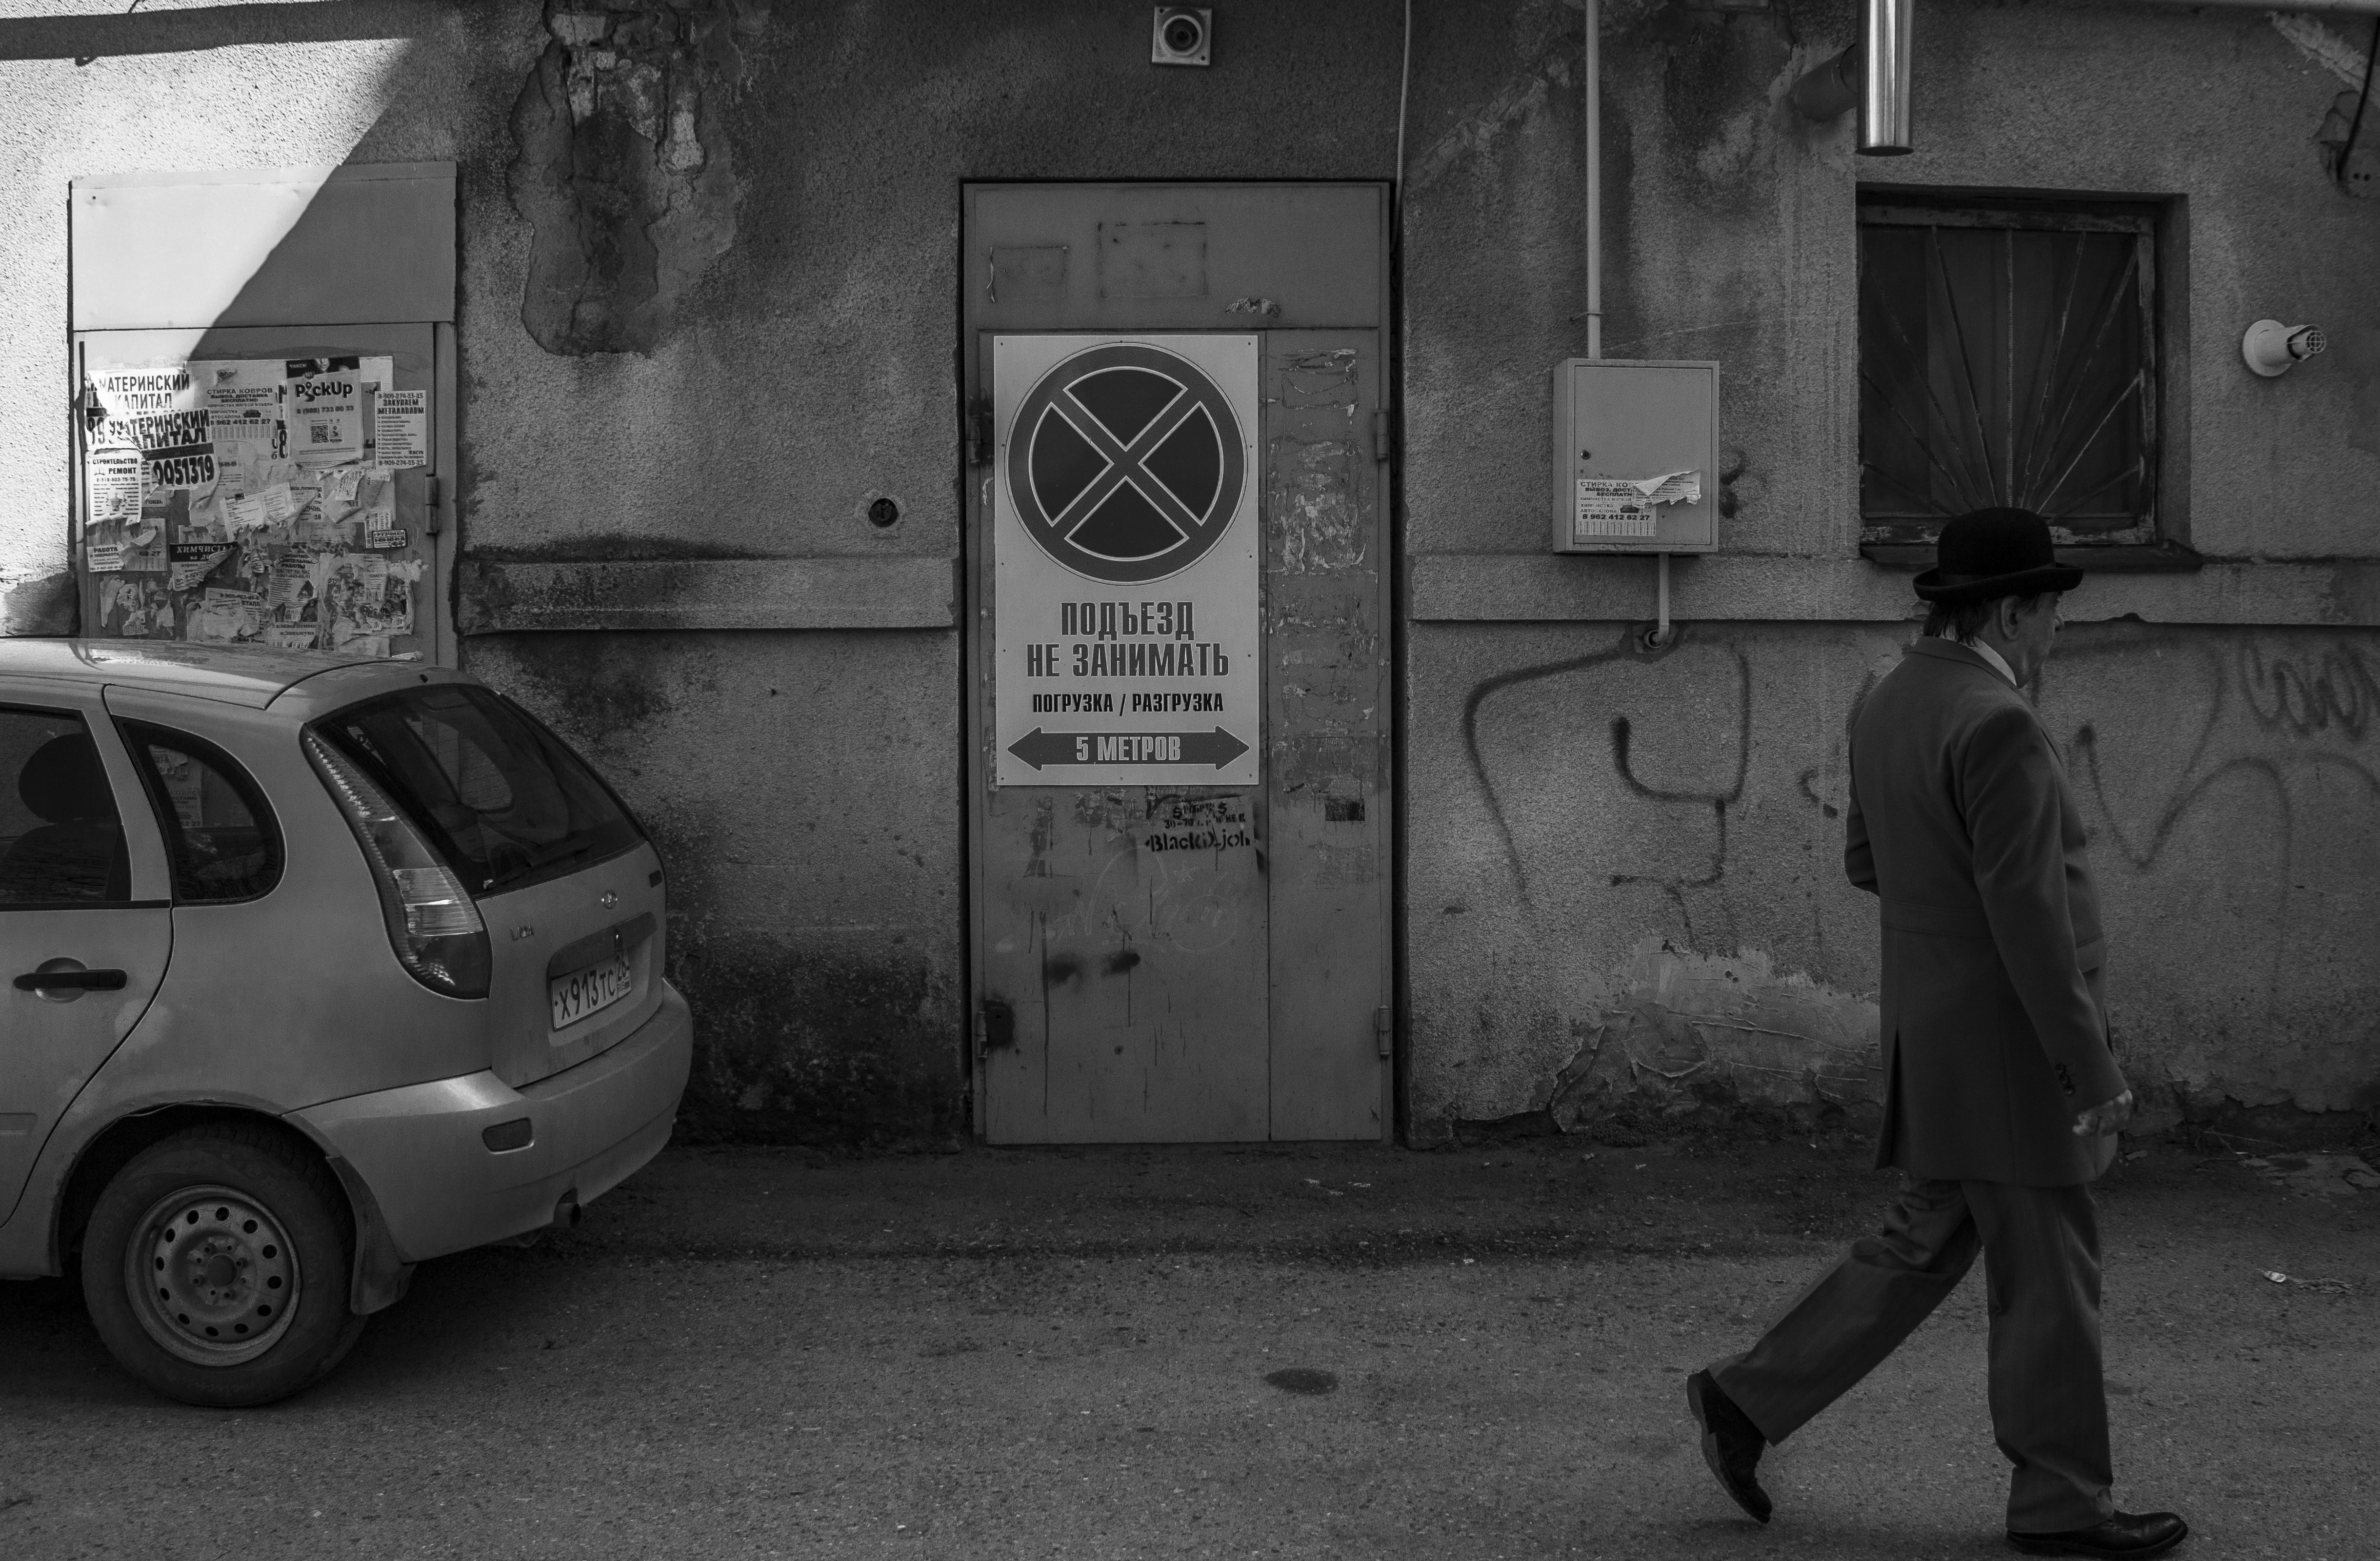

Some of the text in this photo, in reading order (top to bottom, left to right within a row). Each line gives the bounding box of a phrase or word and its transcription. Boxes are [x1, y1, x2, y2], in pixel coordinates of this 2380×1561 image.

[1060, 601, 1195, 641] ПОДЪЕЗД
[1026, 642, 1230, 677] НЕ ЗАНИМАТЬ
[1033, 693, 1114, 713] ПОГРУЗКА
[1132, 693, 1223, 712] РАЗГРУЗКА
[1076, 736, 1180, 761] 5 МЕТРОВ
